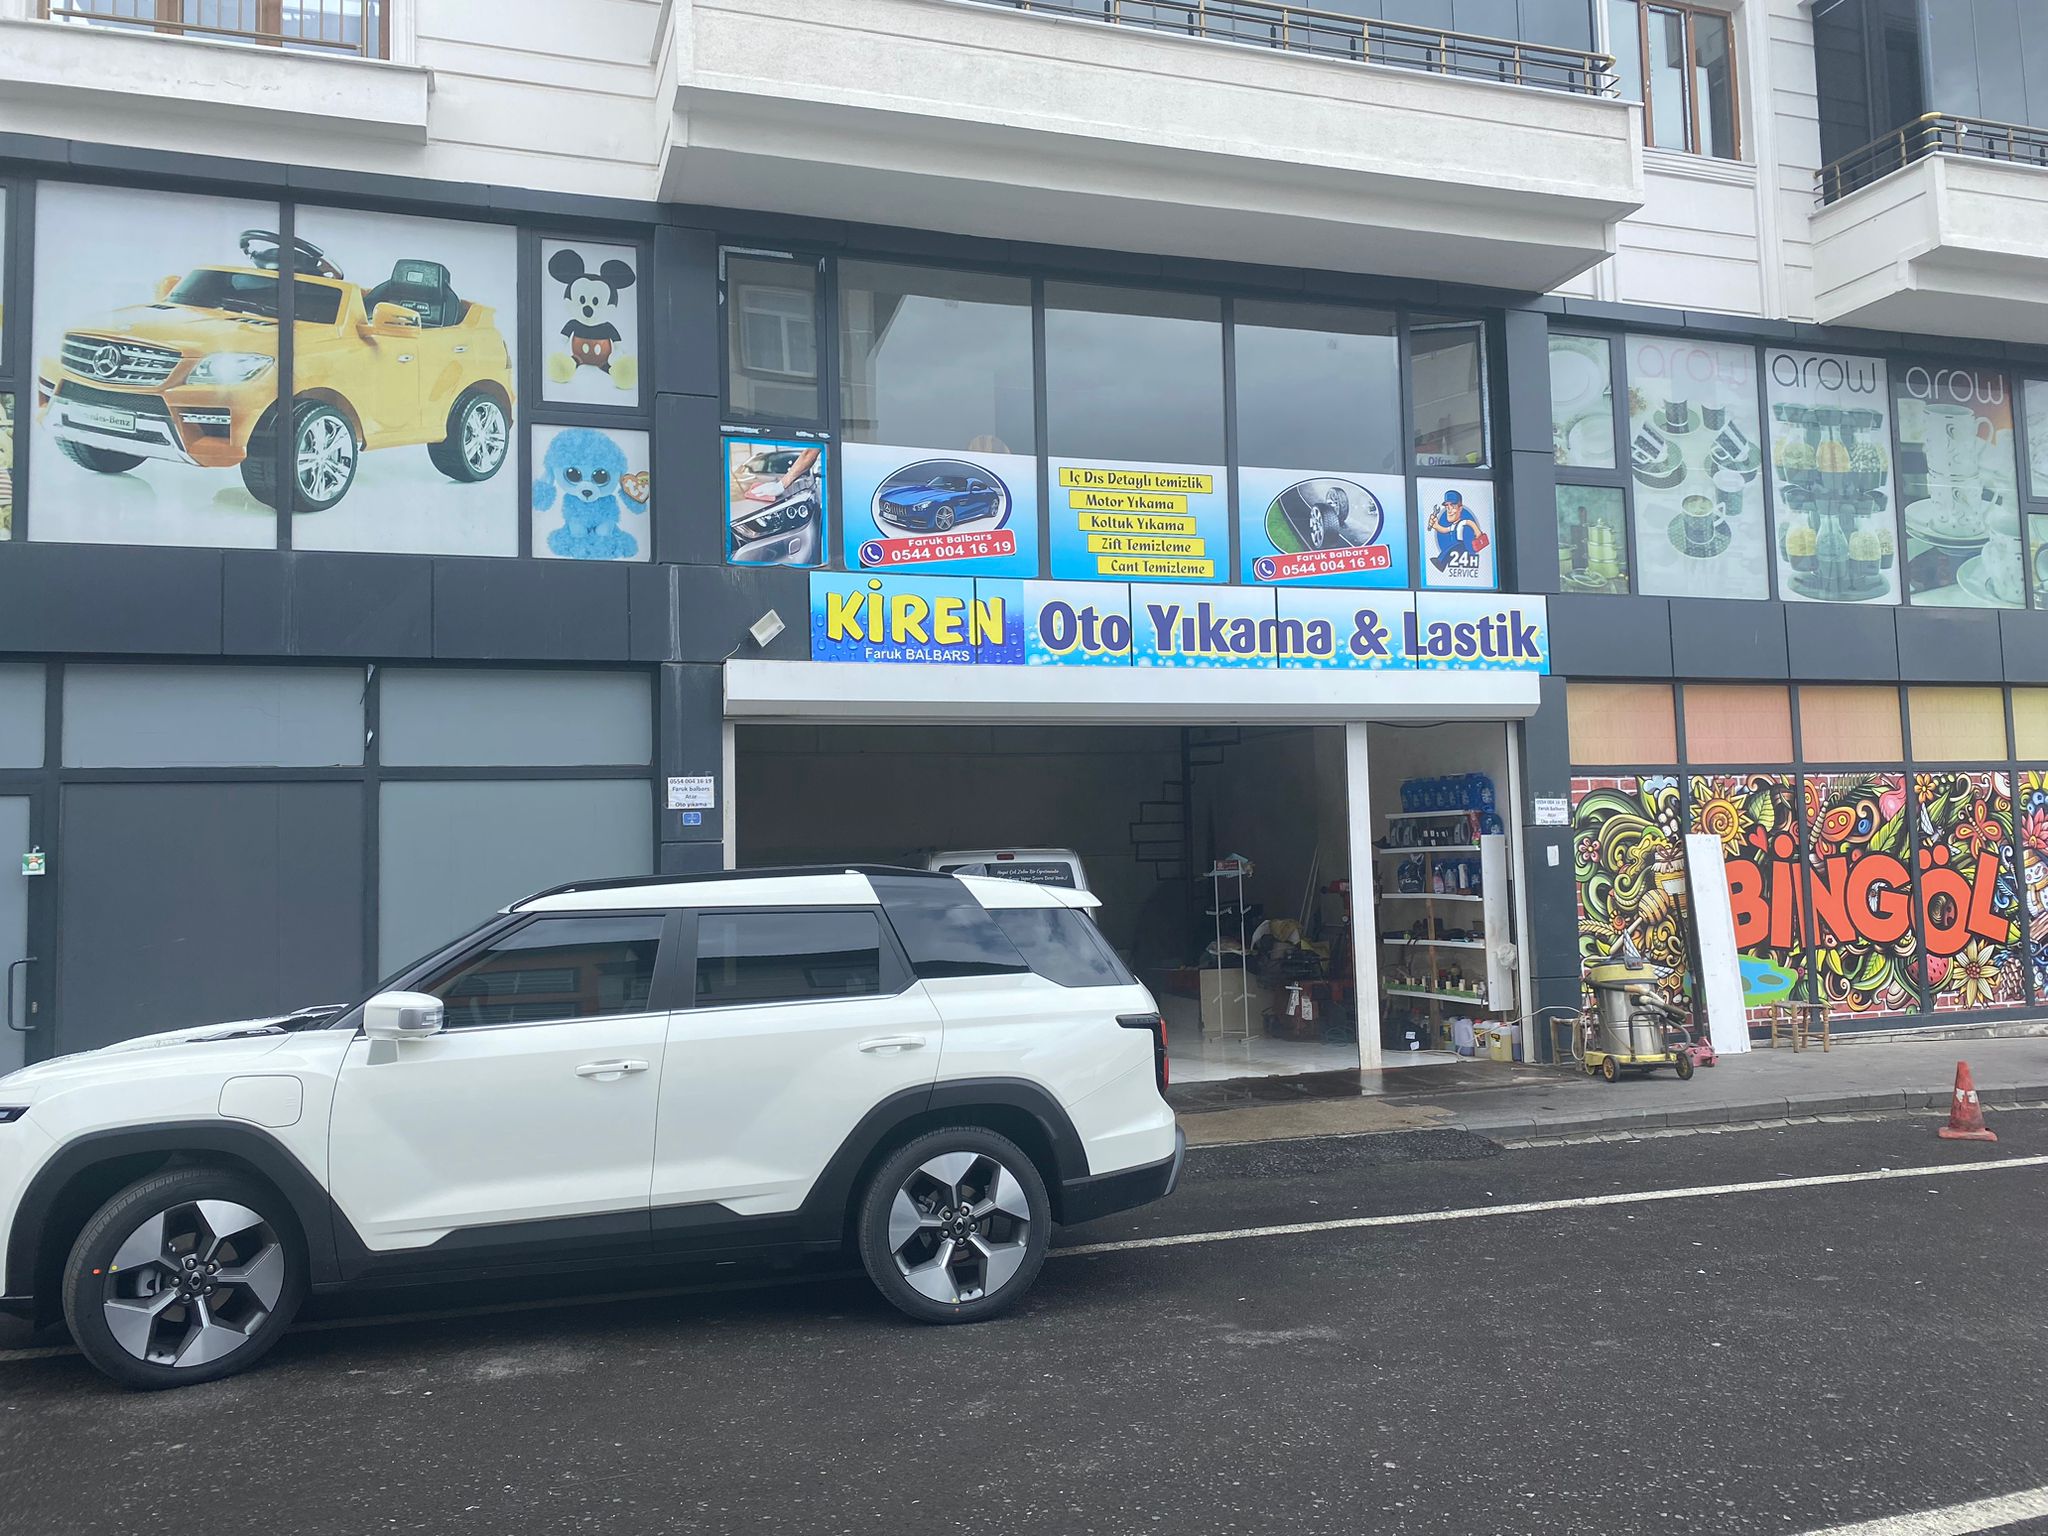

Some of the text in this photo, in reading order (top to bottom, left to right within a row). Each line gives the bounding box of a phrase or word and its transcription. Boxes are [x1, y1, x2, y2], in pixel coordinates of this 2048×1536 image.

[1772, 353, 1876, 394] arow
[1905, 366, 2004, 404] arow
[1107, 472, 1151, 490] Detaylı
[1155, 475, 1203, 489] temizlik
[1085, 494, 1174, 510] Motor Yıkama
[1091, 515, 1184, 532] Koltuk Yıkama
[908, 533, 993, 548] Faruk Balbars
[1101, 537, 1191, 553] Zift Temizleme
[891, 540, 1011, 562] 0544 004 16 19
[1296, 548, 1370, 563] Faruk Balbars
[1449, 550, 1480, 569] 24H
[1111, 558, 1205, 574] Cant Temizleme
[1282, 555, 1387, 576] 0544 004 16 19
[1448, 568, 1479, 579] SERVICE
[826, 579, 1006, 646] KİREN
[1039, 599, 1543, 660] Oto Yıkama & Lastik
[865, 647, 970, 662] Faruk BALBARS
[1725, 835, 2011, 955] BİNGÖL
